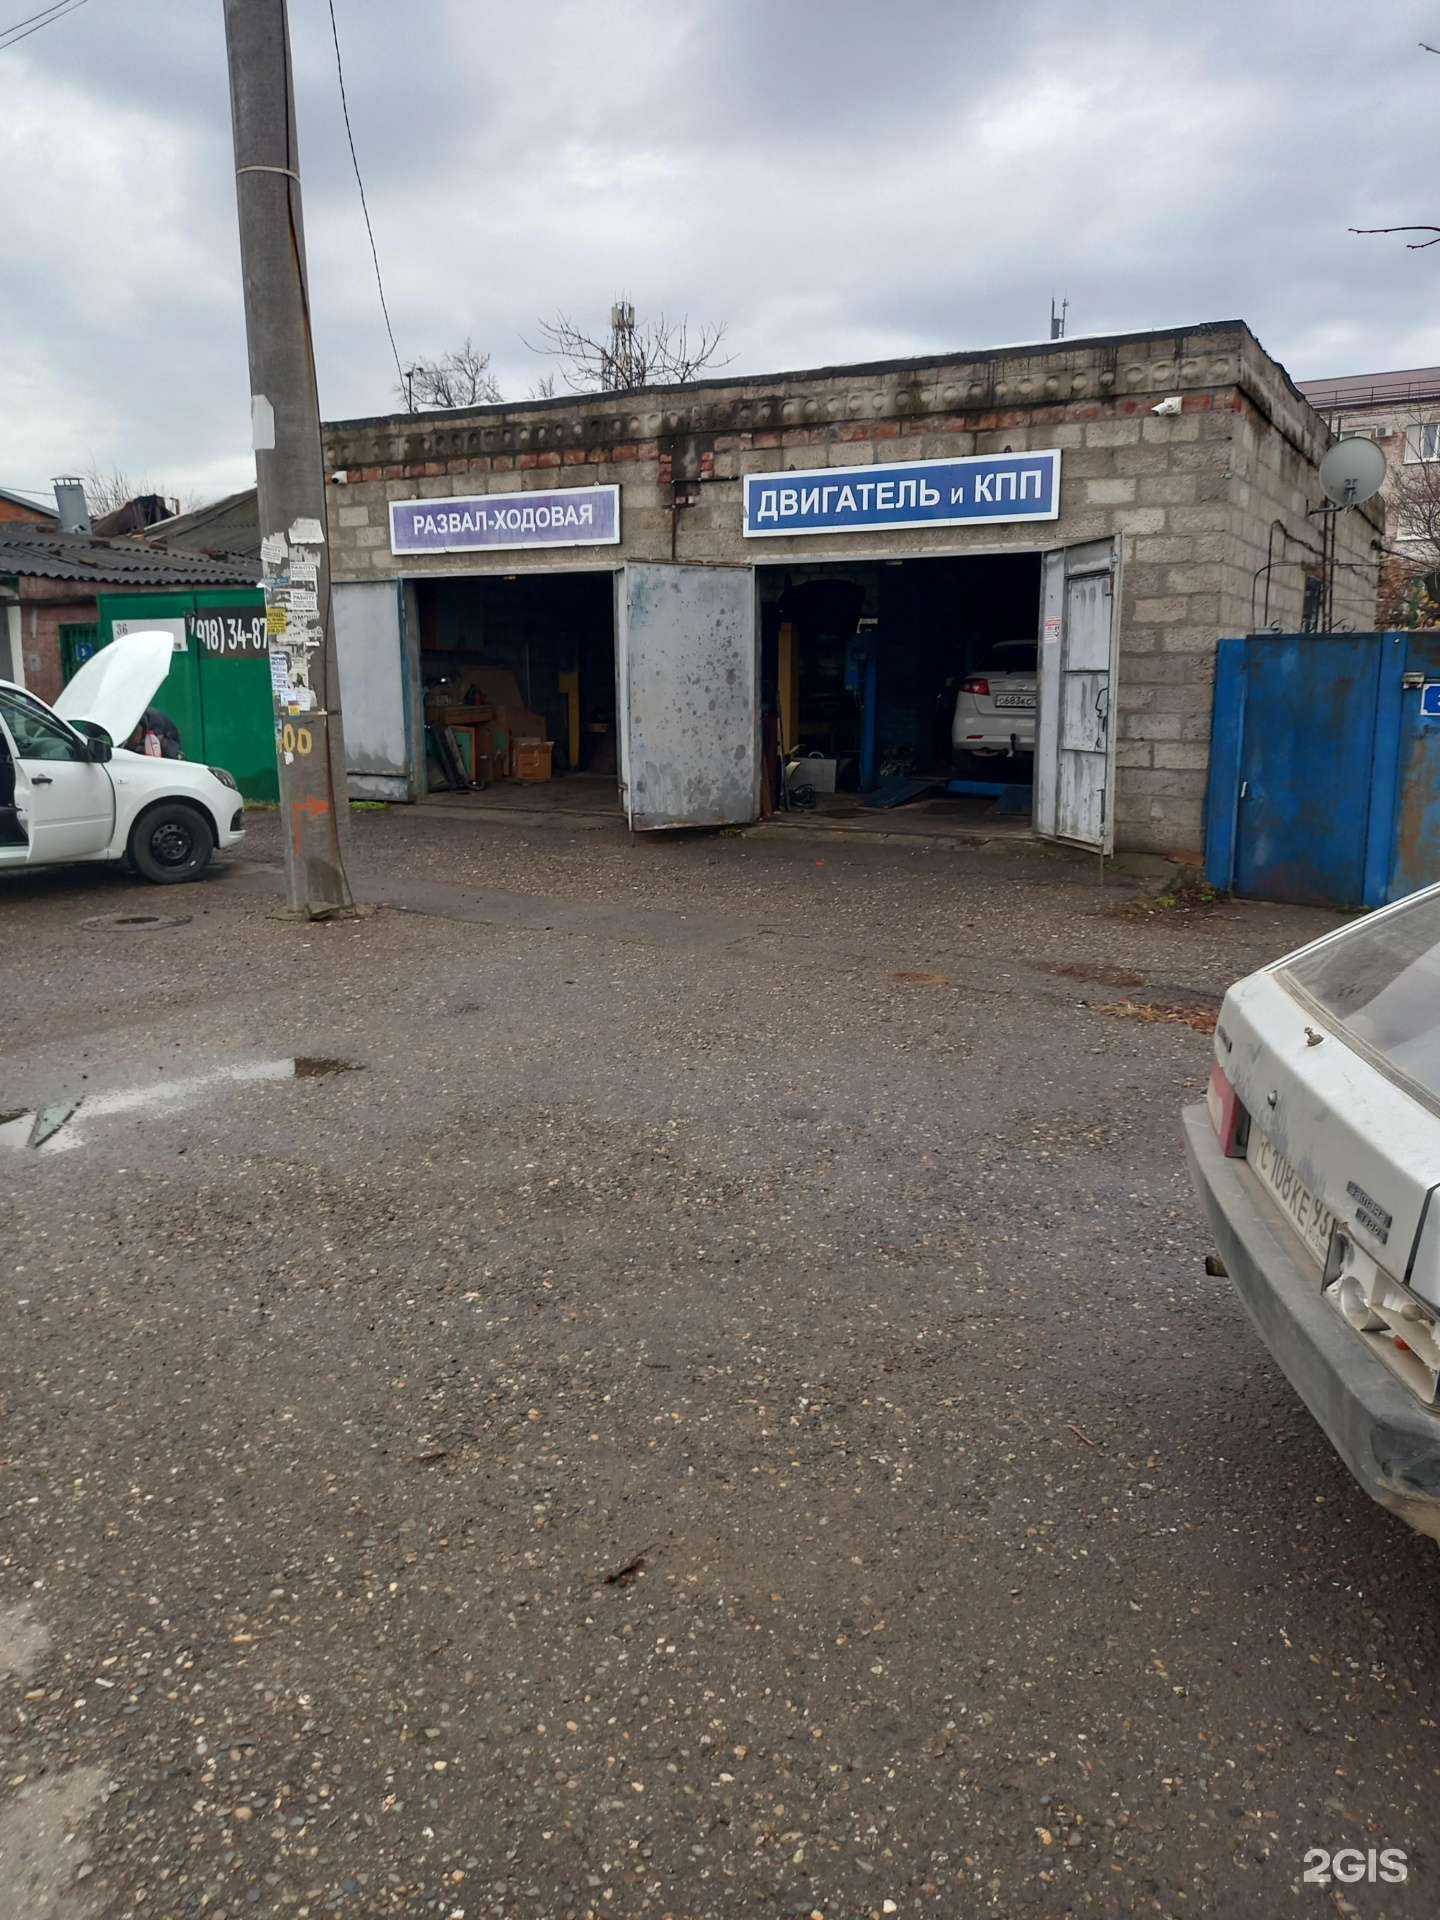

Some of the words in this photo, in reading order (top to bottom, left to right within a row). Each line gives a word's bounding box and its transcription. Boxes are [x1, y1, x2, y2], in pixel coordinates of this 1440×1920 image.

[757, 479, 940, 522] ДВИГАТЕЛЬ
[974, 470, 1042, 503] КПП
[413, 504, 593, 535] РАЗВАЛ-ХОДОВАЯ
